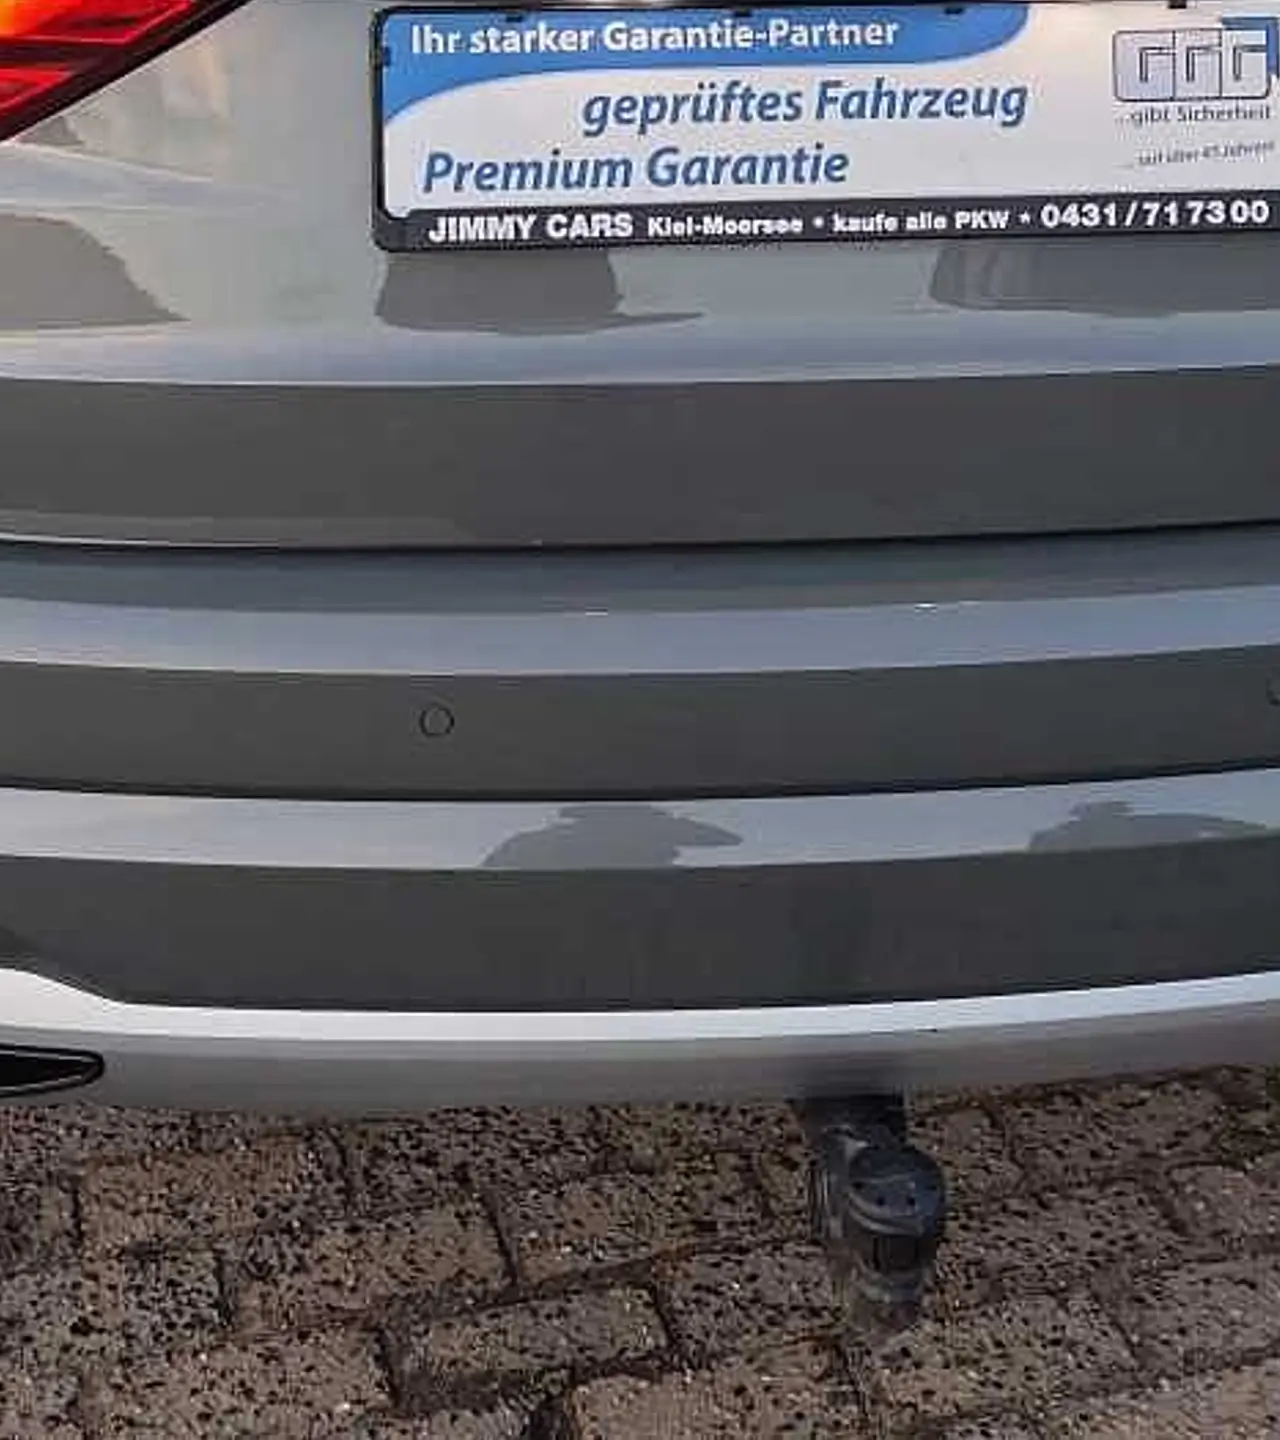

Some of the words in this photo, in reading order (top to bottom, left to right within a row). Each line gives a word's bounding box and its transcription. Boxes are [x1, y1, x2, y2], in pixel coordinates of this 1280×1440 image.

[411, 24, 463, 54] Ihr
[469, 23, 593, 54] starker
[603, 17, 900, 51] Garantie-Partner
[582, 79, 803, 137] geprüftes
[816, 76, 1029, 127] Fahrzeug
[423, 148, 632, 193] Premium
[646, 143, 850, 187] Garantie
[428, 215, 535, 242] JIMMY
[547, 213, 633, 238] CARS
[833, 214, 898, 233] kaufe
[906, 211, 947, 230] alle
[955, 209, 1011, 229] PKW
